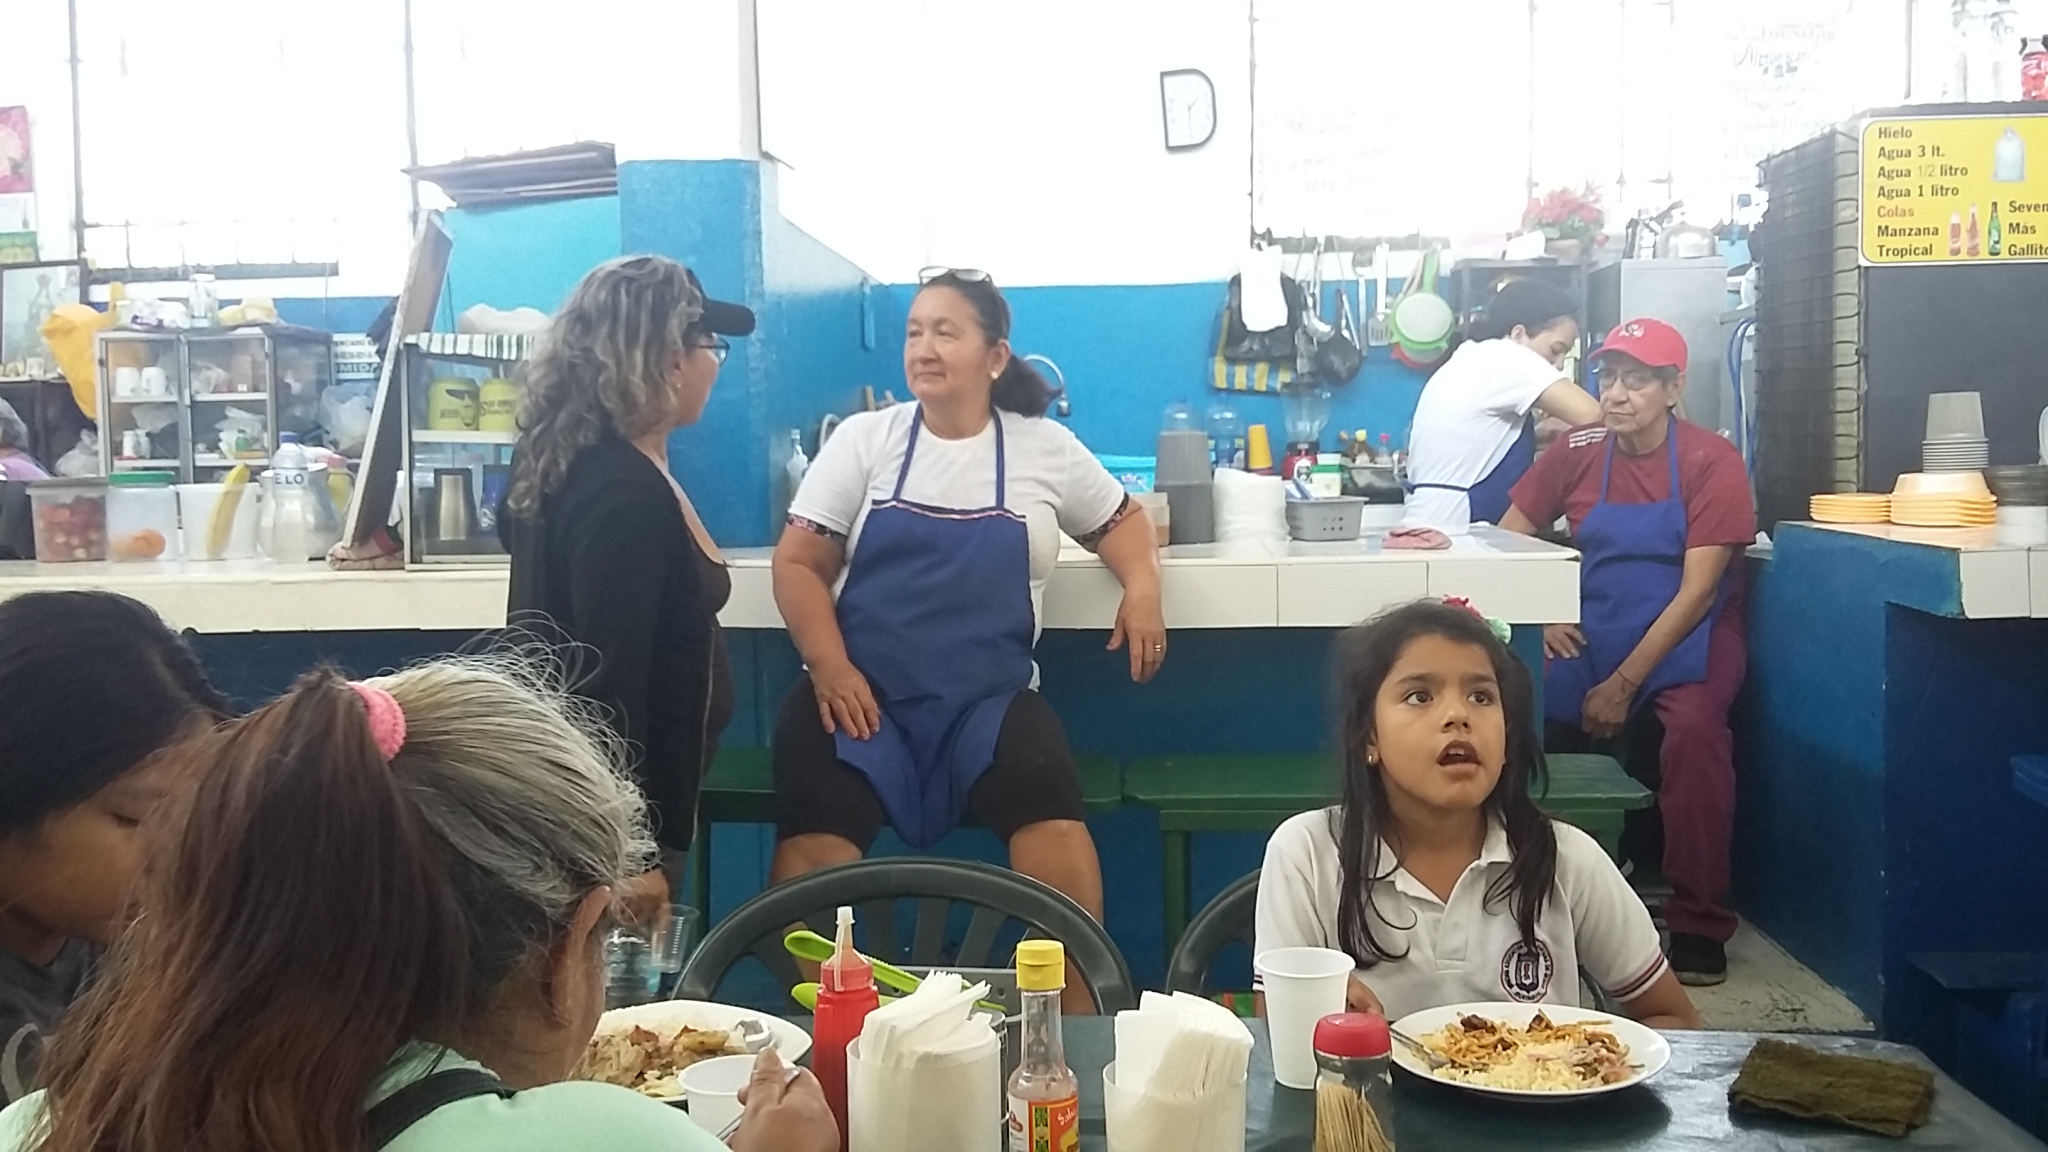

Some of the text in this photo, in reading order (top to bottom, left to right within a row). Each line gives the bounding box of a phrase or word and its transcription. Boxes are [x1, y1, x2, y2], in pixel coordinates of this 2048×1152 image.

[1878, 126, 1913, 139] Hielo
[1877, 146, 1912, 161] Agua
[1918, 145, 1926, 157] 3
[1877, 164, 1968, 181] Agua 1/2 litro
[1877, 184, 1959, 201] Agua 1 litro
[1877, 205, 1914, 218] Colas
[1877, 225, 1939, 238] Manzana
[2008, 222, 2037, 235] Más
[1877, 243, 1933, 259] Tropical
